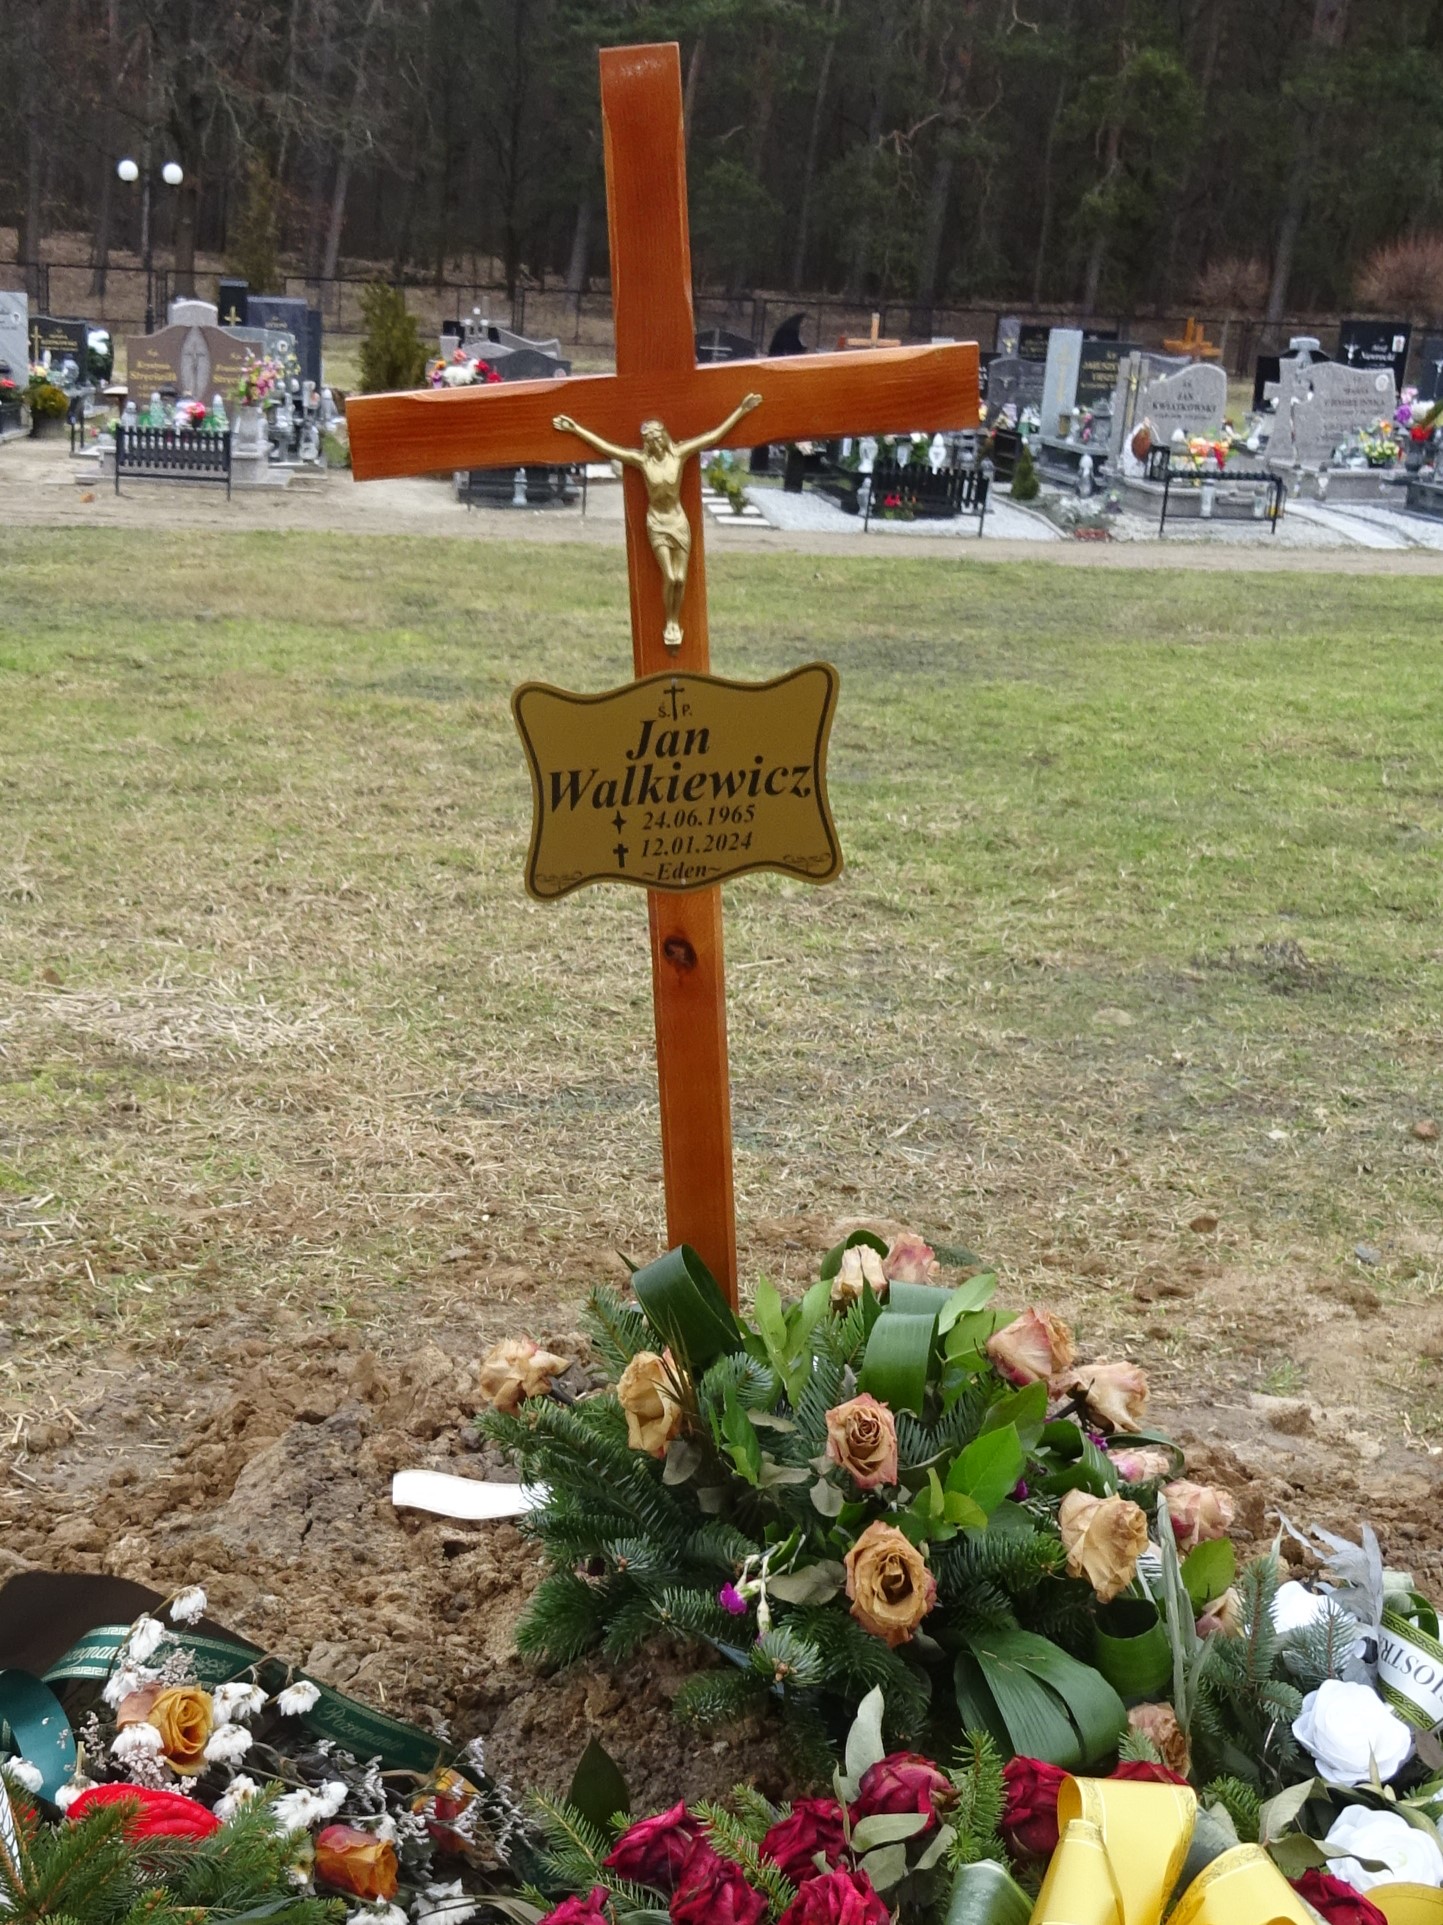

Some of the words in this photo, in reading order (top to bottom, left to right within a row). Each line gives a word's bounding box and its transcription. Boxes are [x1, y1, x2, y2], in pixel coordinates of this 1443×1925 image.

[626, 719, 711, 761] Jan
[549, 755, 813, 813] Walkiewicz
[640, 804, 756, 831] 24.06.1965
[640, 831, 753, 858] 12.01.2024
